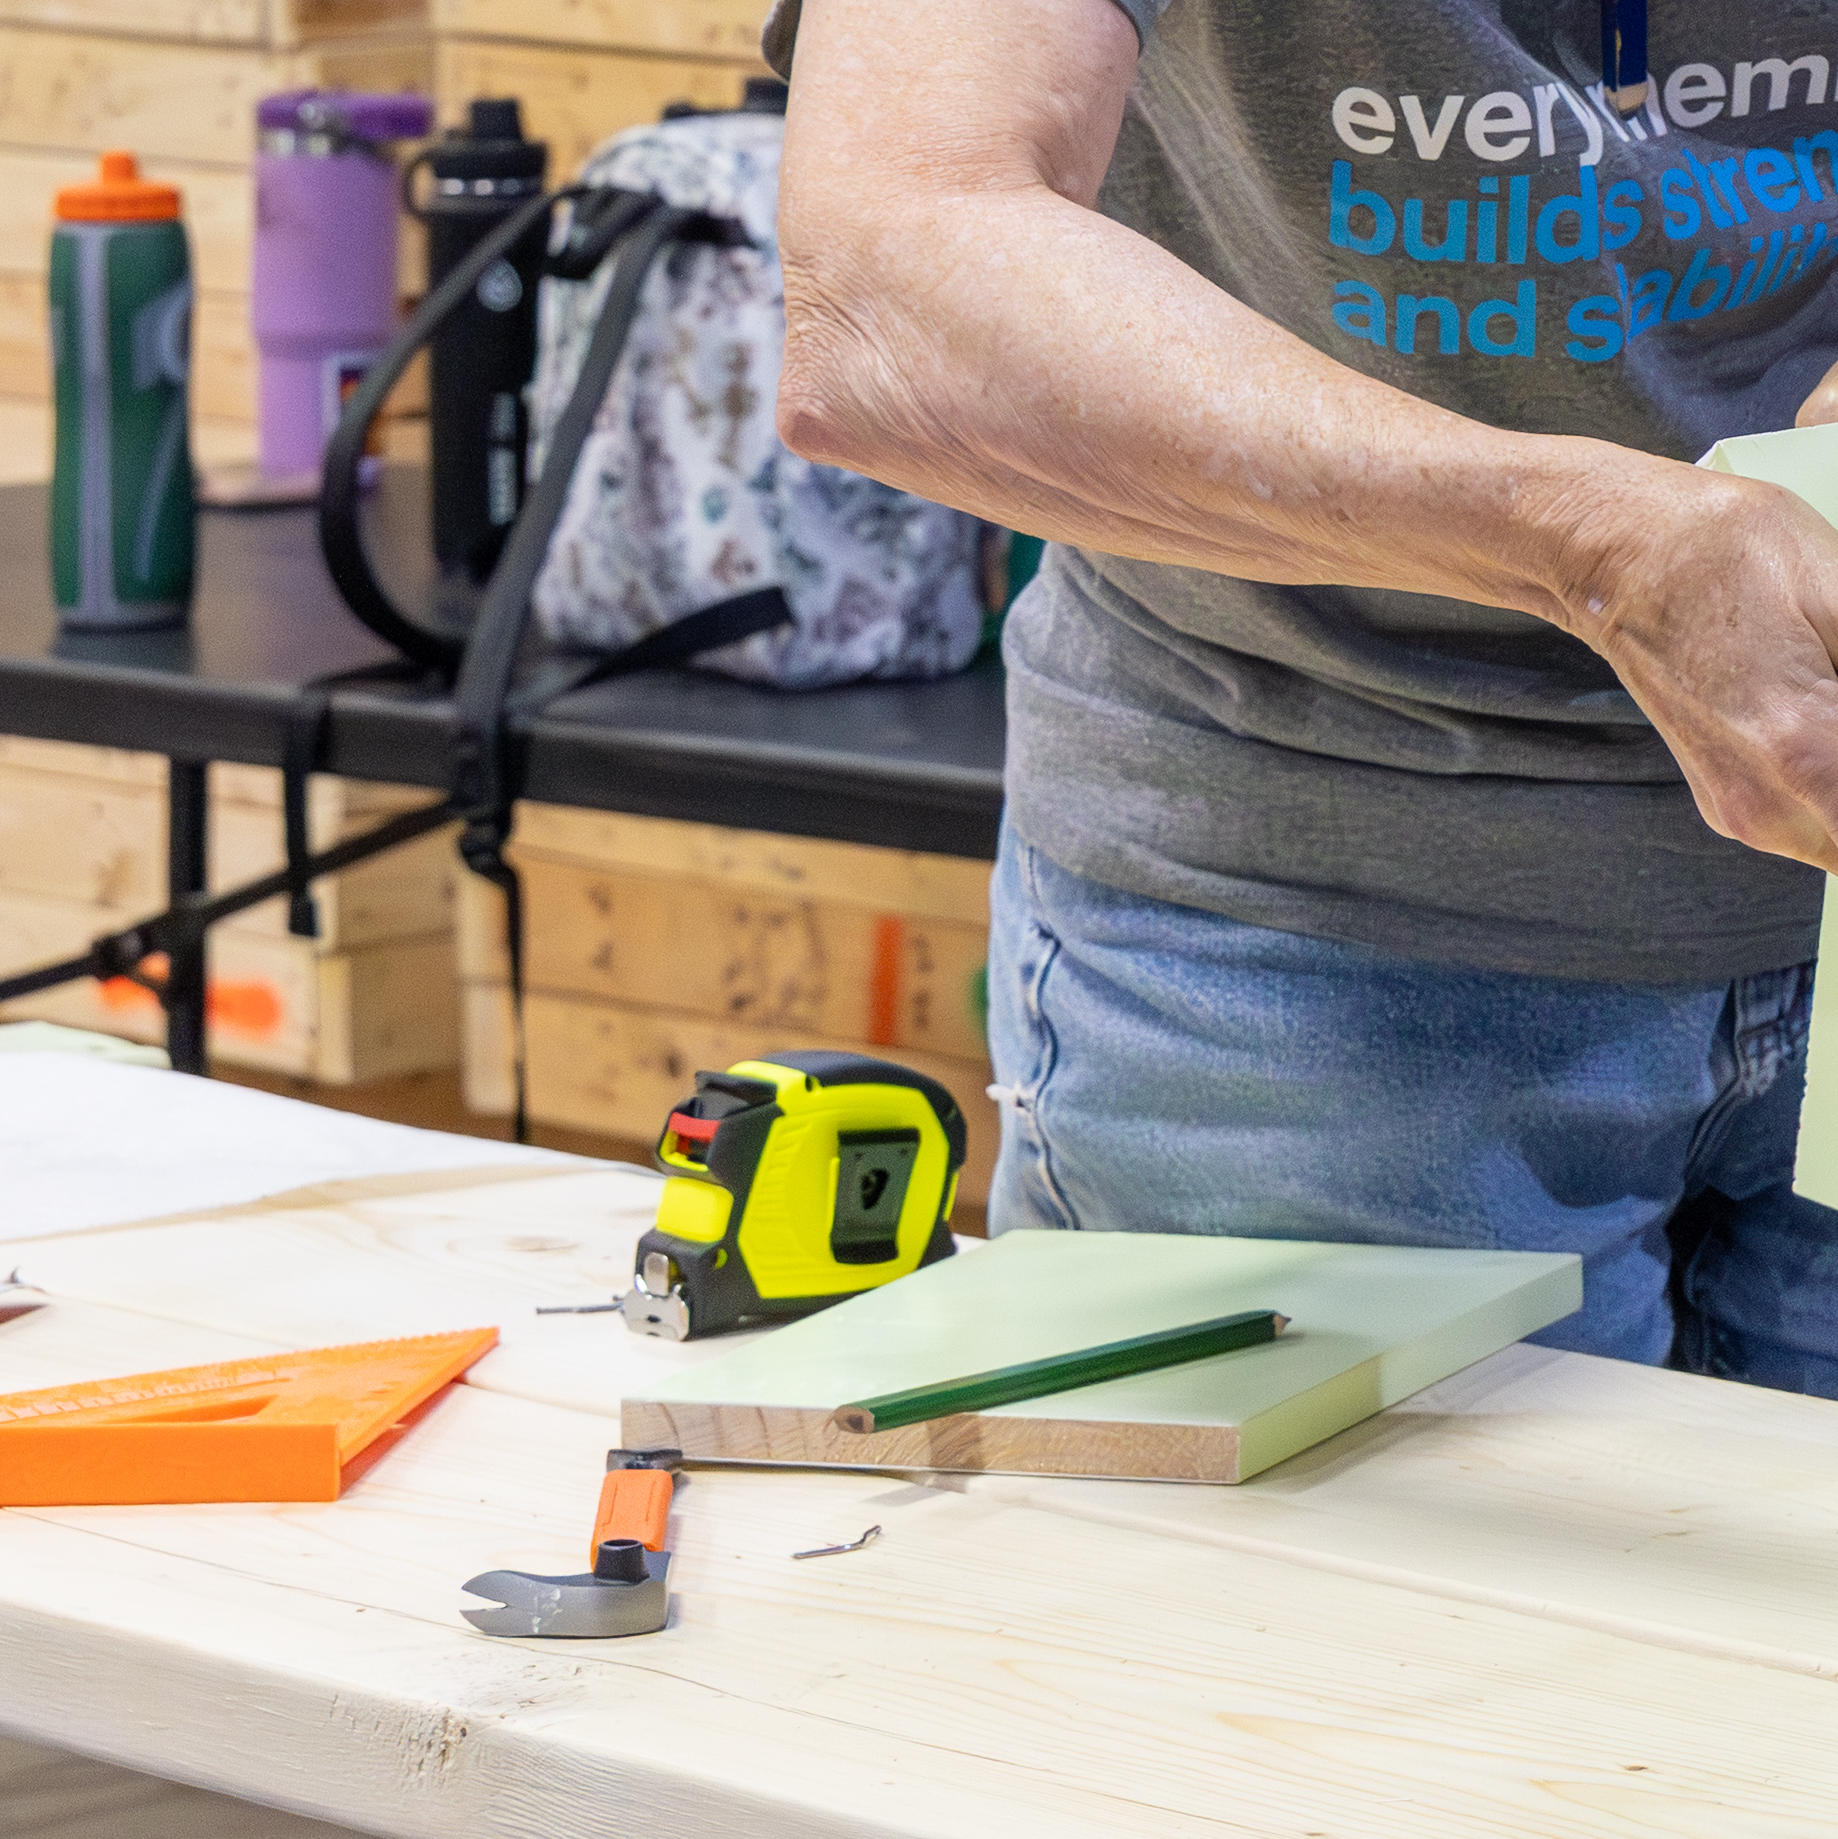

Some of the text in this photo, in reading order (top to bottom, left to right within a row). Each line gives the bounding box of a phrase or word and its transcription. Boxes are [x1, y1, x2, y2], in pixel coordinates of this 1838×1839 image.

[1331, 81, 1604, 167] every
[1328, 160, 1645, 265] builds
[1331, 279, 1536, 358] and
